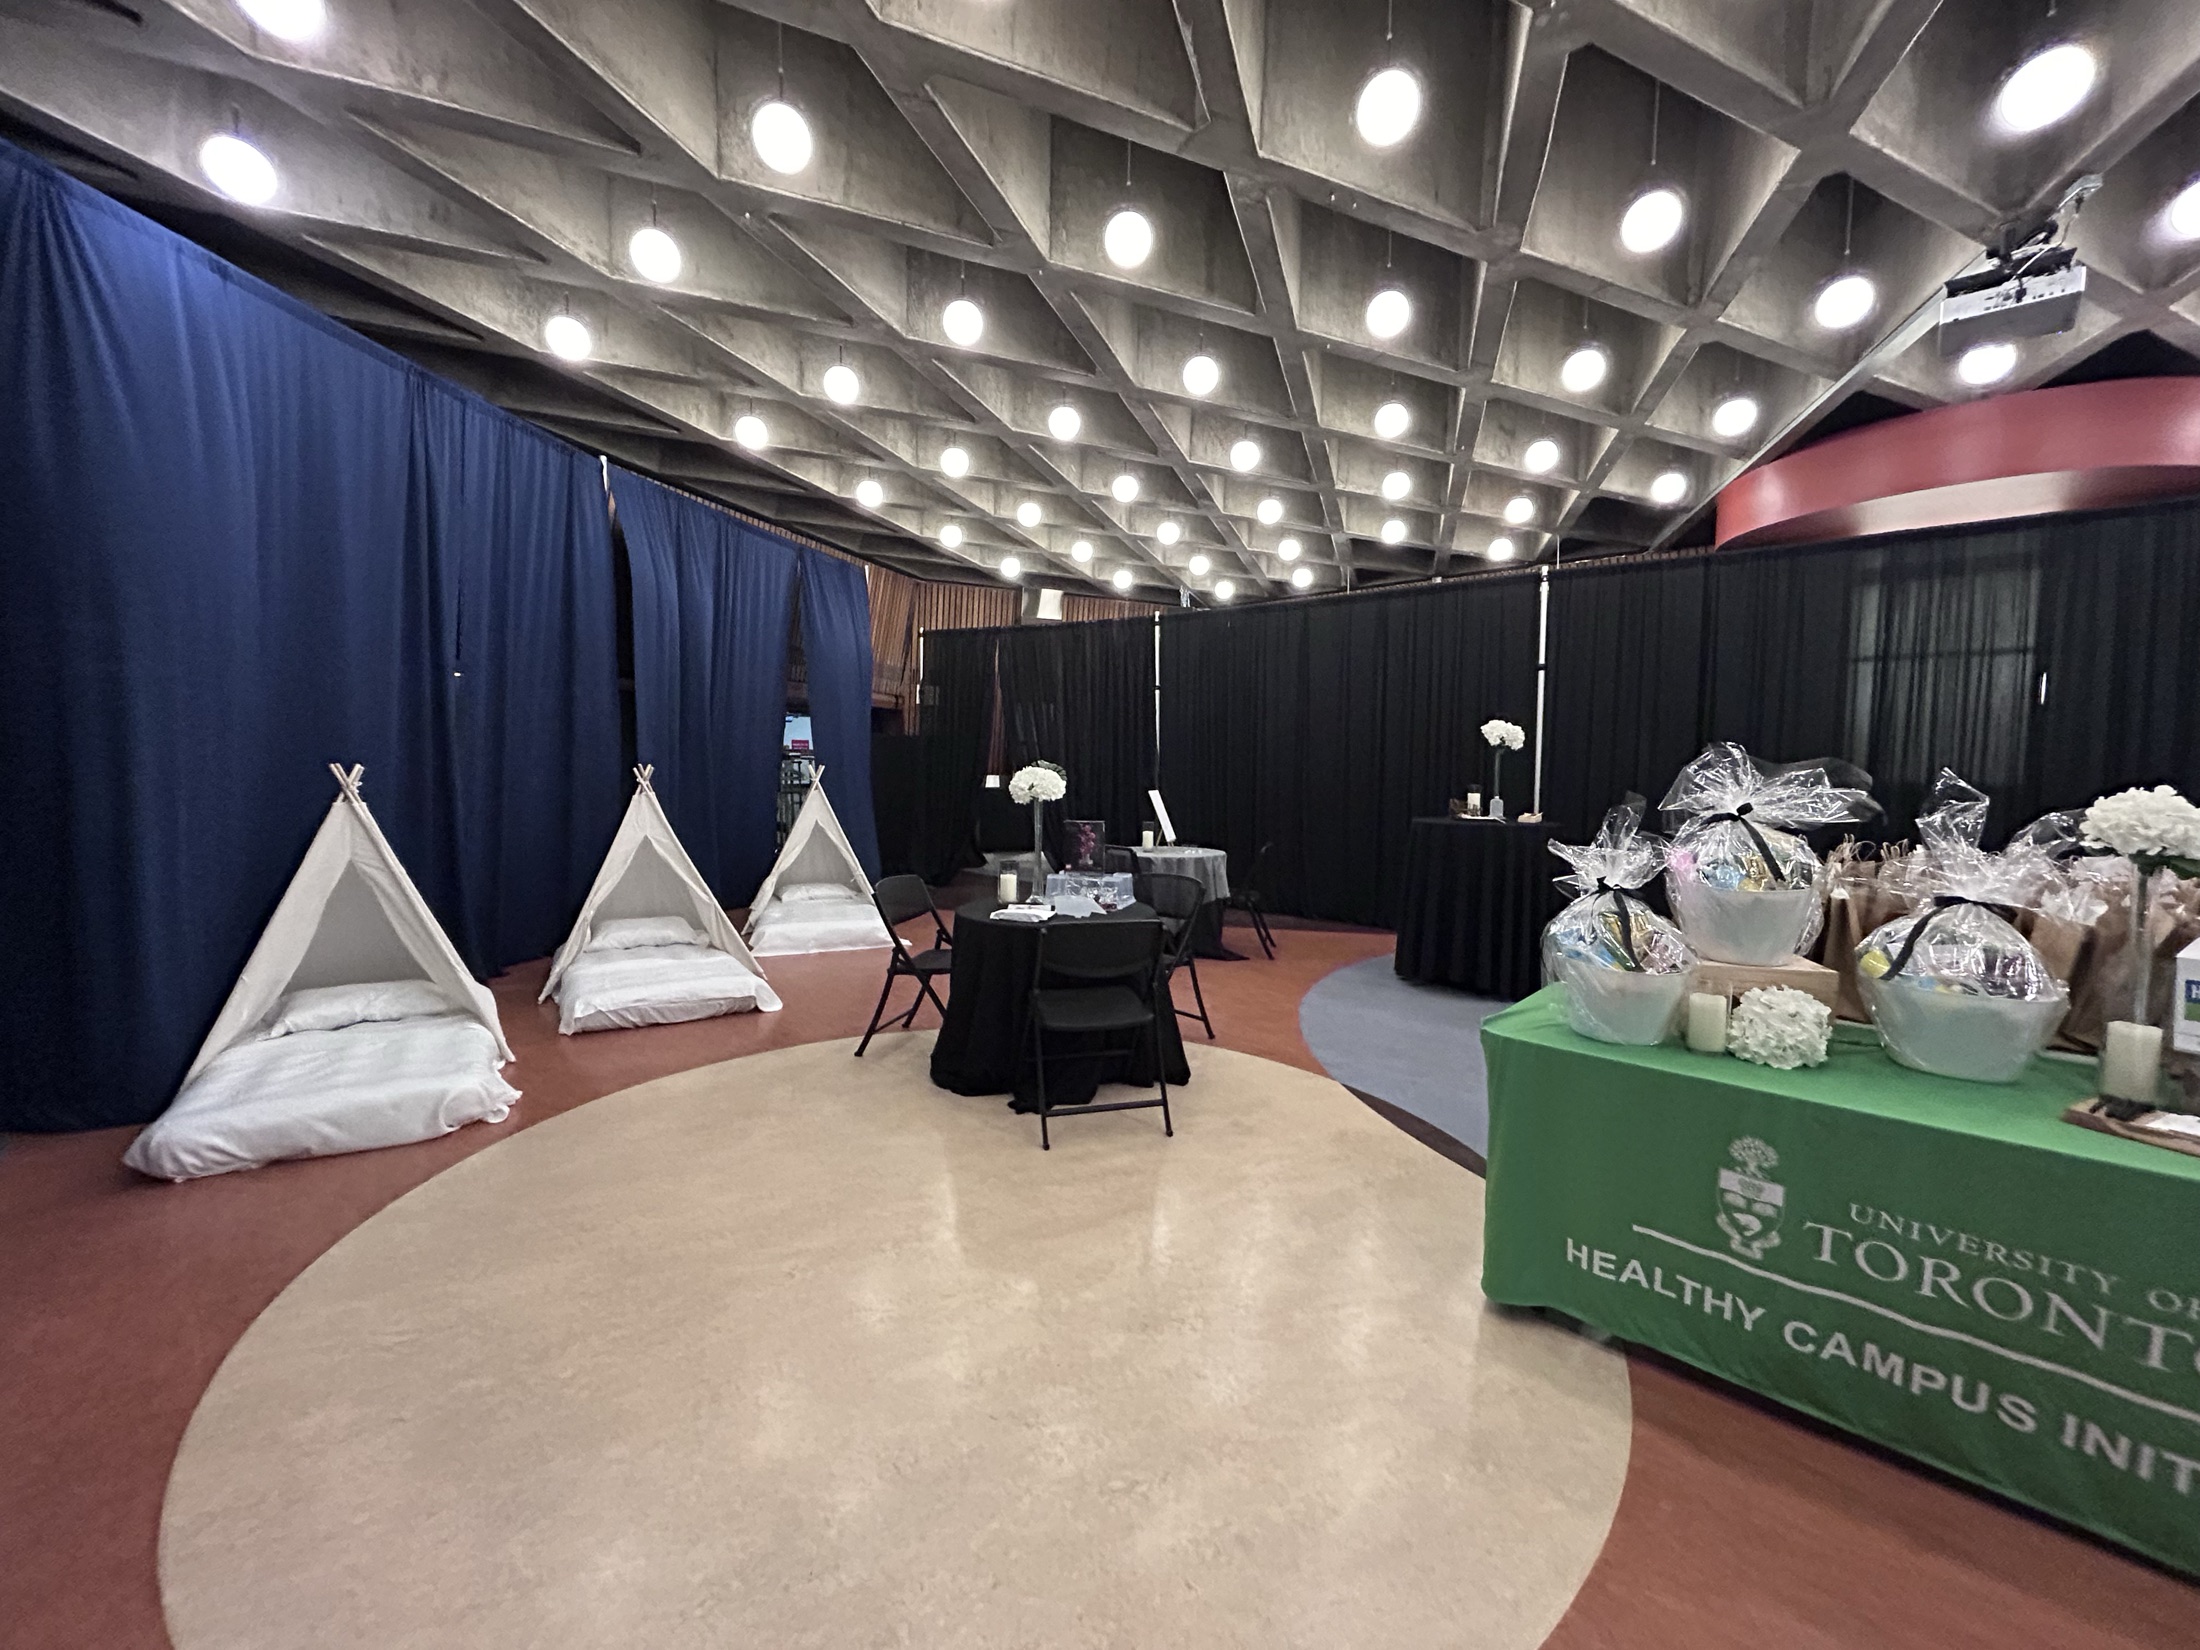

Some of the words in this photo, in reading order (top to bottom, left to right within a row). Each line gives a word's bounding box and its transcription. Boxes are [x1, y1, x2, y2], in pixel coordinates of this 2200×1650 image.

[1803, 1221, 2200, 1375] TORONT
[1850, 1202, 2119, 1295] UNIVERSITY
[1566, 1237, 1767, 1332] HEALTHY
[1783, 1320, 2038, 1433] CAMPUS
[2062, 1411, 2200, 1496] INIT
